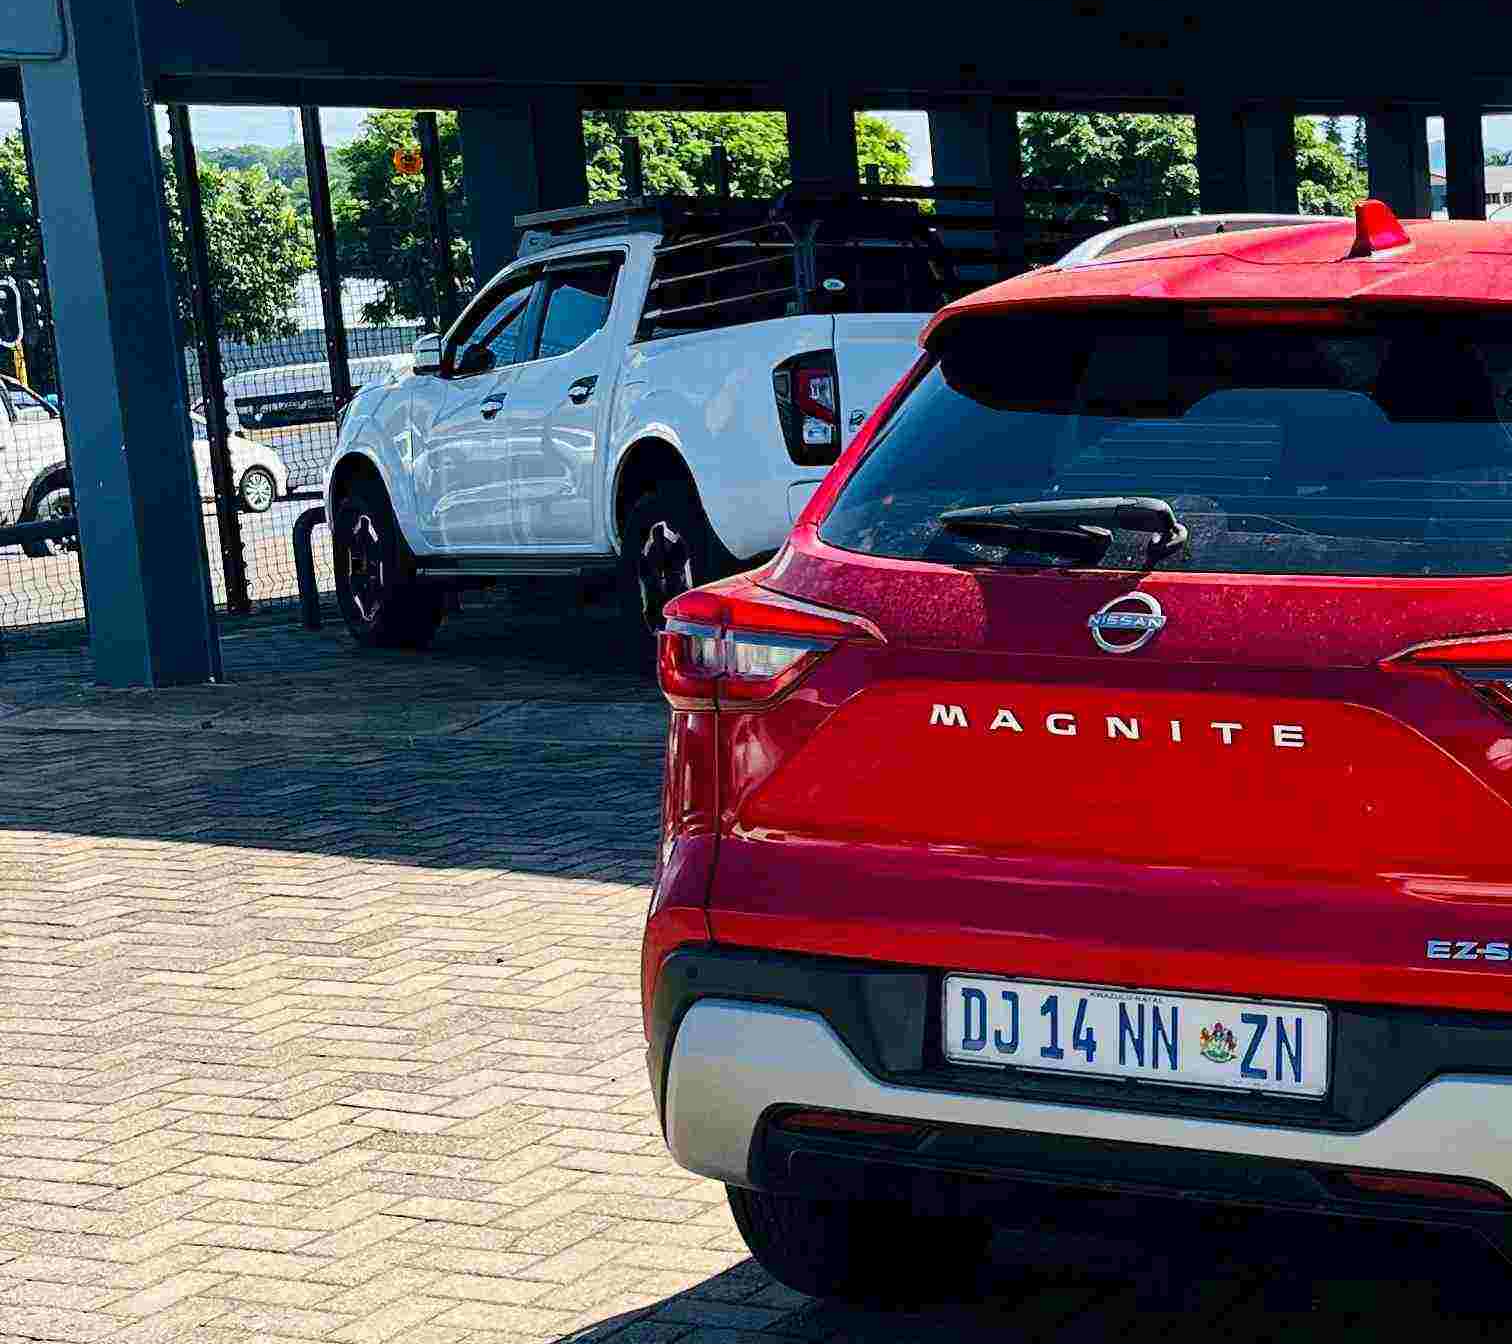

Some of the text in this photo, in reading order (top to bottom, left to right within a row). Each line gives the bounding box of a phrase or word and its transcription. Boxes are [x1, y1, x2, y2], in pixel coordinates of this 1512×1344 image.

[1087, 613, 1166, 629] NISSAN
[929, 703, 1305, 748] MAGNITE
[961, 987, 1304, 1083] DJ 14 NN ZN
